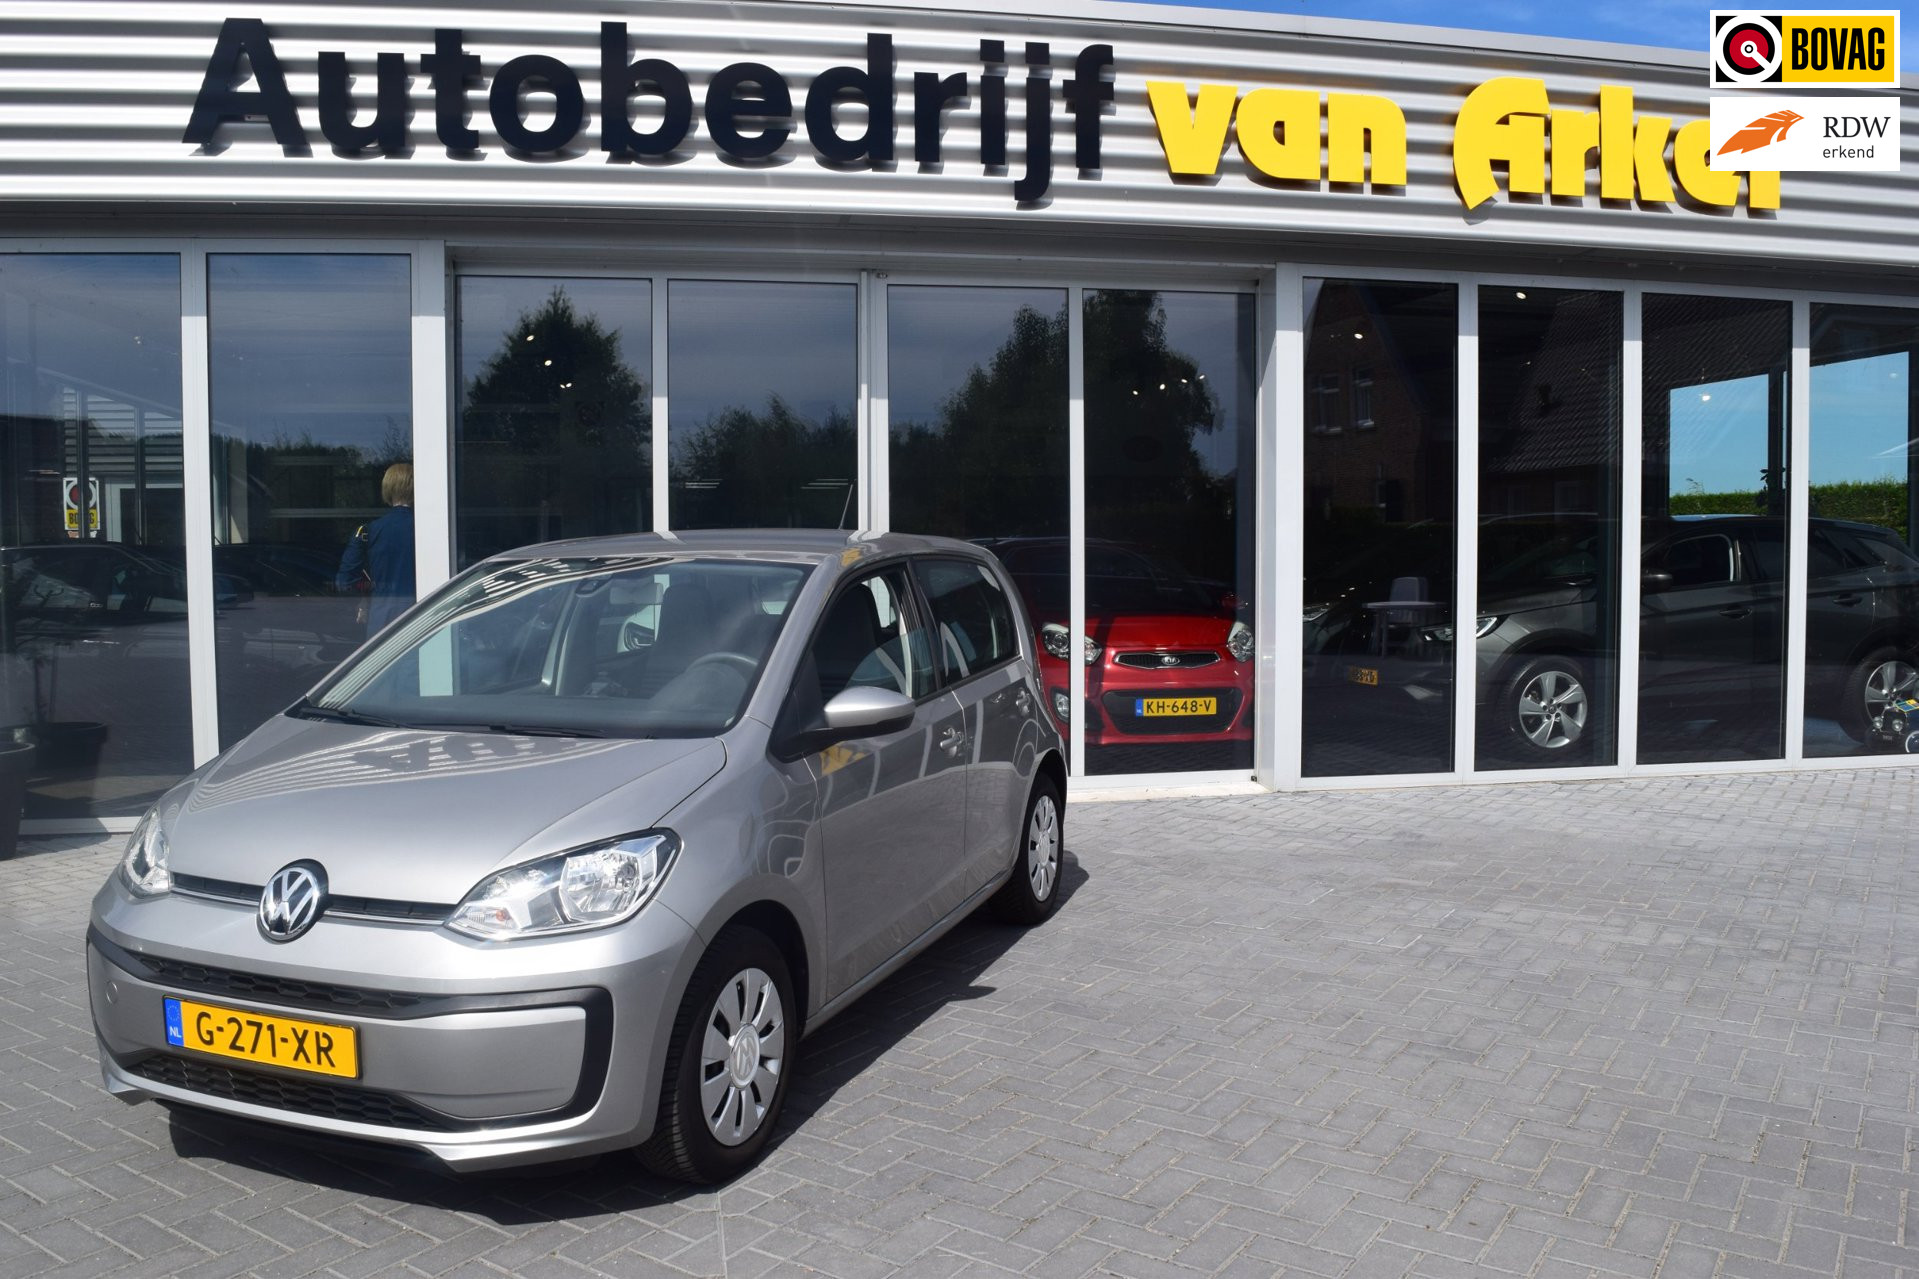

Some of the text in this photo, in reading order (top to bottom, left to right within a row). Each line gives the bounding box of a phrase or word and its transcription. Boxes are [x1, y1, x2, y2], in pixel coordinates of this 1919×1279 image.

[182, 18, 1114, 201] Autobedrijf
[1147, 82, 1407, 187] van
[1146, 700, 1211, 714] KH-648-V
[169, 1026, 182, 1038] NL
[196, 1011, 336, 1068] G-271-XR
